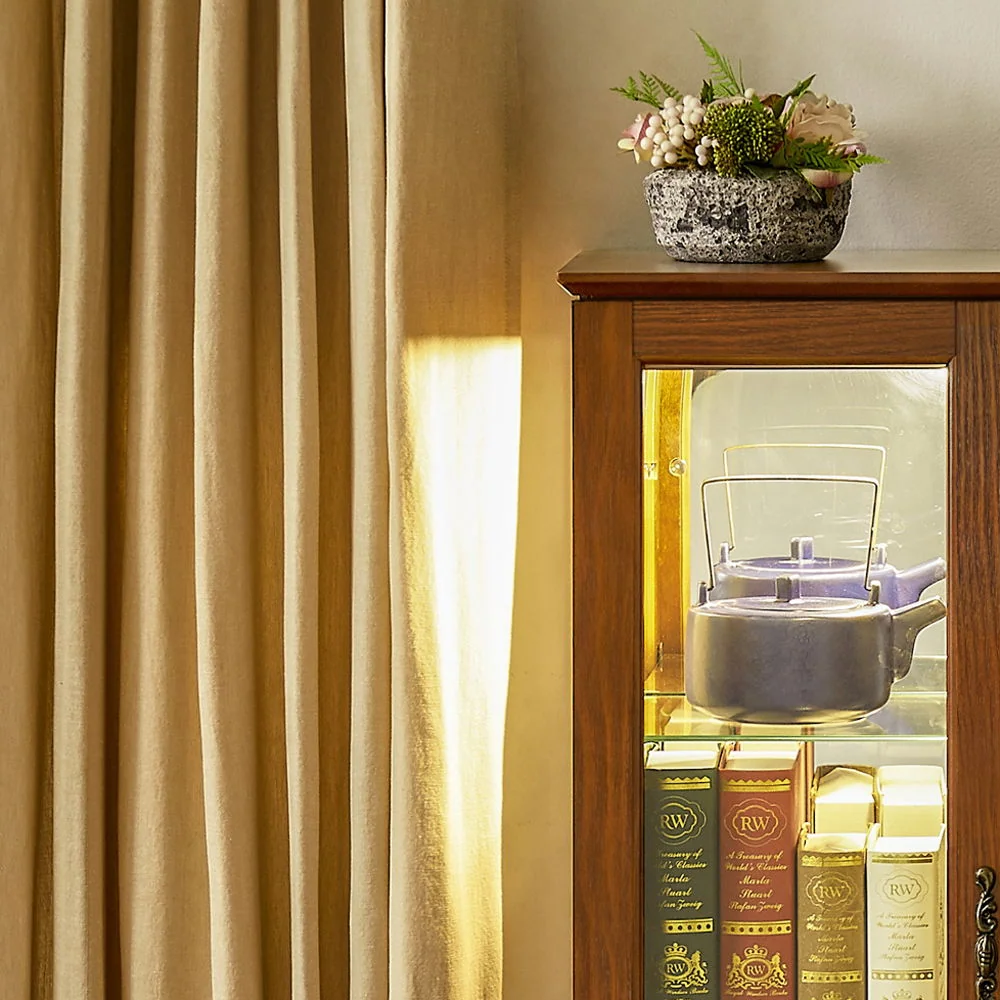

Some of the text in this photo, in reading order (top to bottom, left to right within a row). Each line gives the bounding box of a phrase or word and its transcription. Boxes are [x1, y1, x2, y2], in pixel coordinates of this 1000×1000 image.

[661, 814, 688, 829] RW
[740, 816, 771, 831] RW
[660, 848, 703, 860] reasury of
[736, 851, 772, 862] Treasury
[773, 850, 784, 862] of
[819, 885, 845, 899] RW
[890, 884, 915, 896] RW
[666, 963, 685, 974] RW
[747, 965, 766, 976] RW
